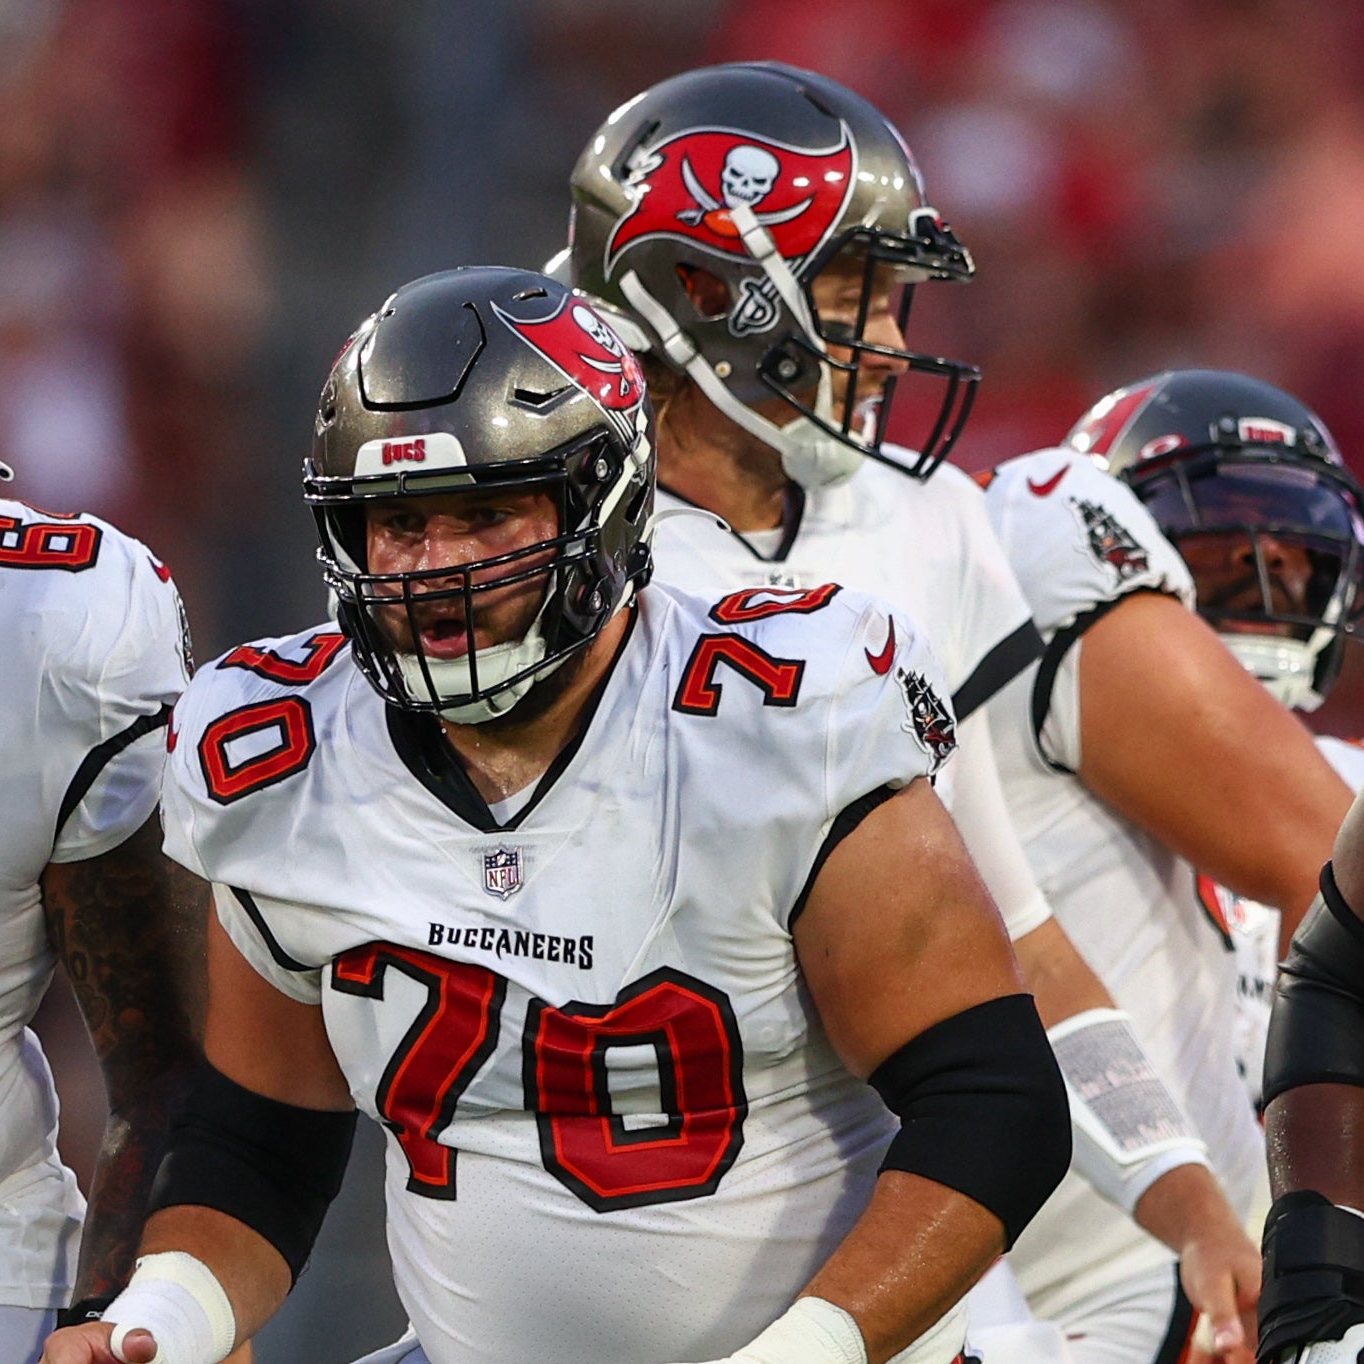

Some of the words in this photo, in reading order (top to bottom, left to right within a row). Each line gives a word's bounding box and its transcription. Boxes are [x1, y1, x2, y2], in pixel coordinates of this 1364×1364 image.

[673, 583, 843, 717] 70
[488, 868, 518, 888] NFL
[428, 922, 594, 970] BUCCANEERS
[331, 941, 748, 1213] 70
